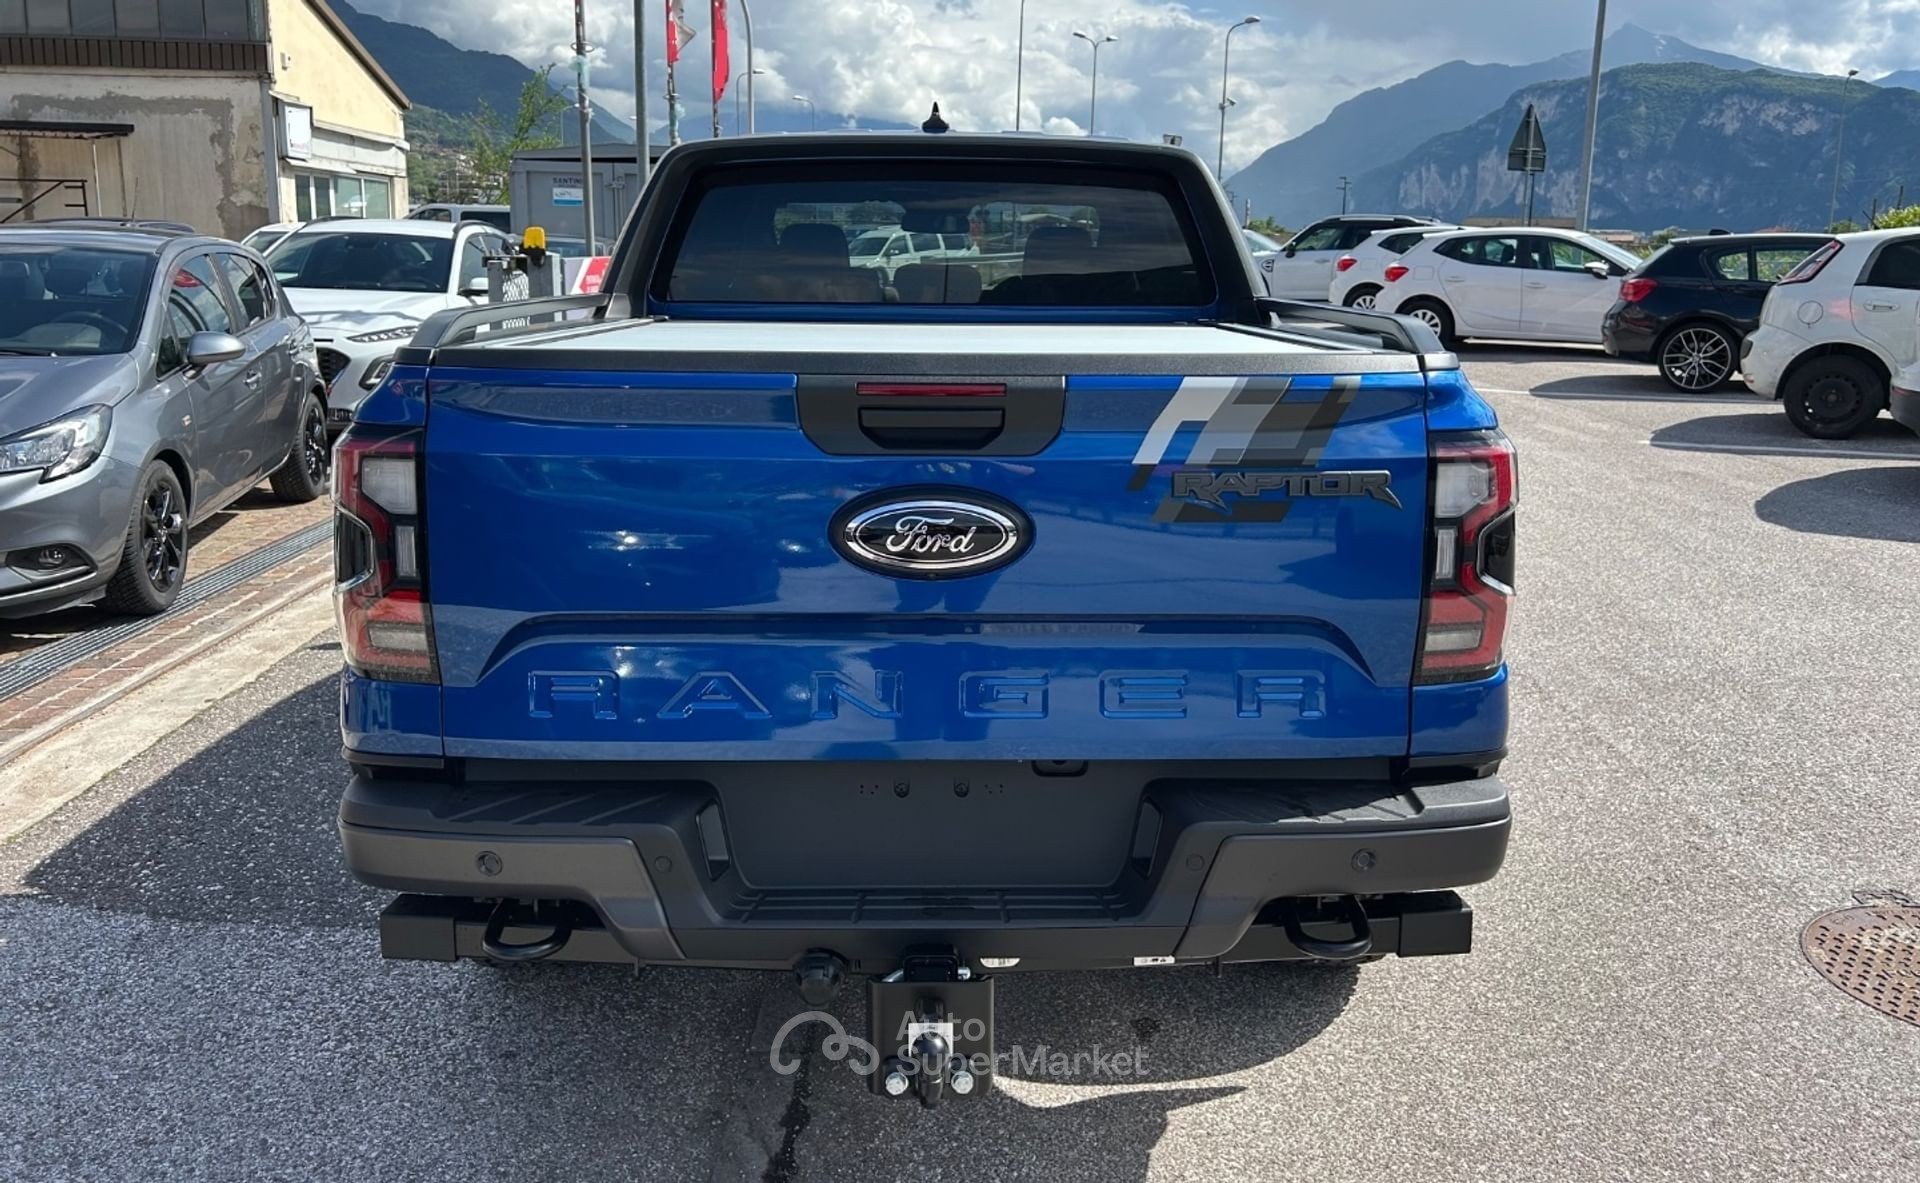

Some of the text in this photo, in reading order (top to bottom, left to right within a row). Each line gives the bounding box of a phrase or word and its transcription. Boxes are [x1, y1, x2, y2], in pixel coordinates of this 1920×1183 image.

[1174, 471, 1402, 512] RAPTOR
[885, 515, 977, 553] Ford
[527, 669, 1327, 720] RANGER
